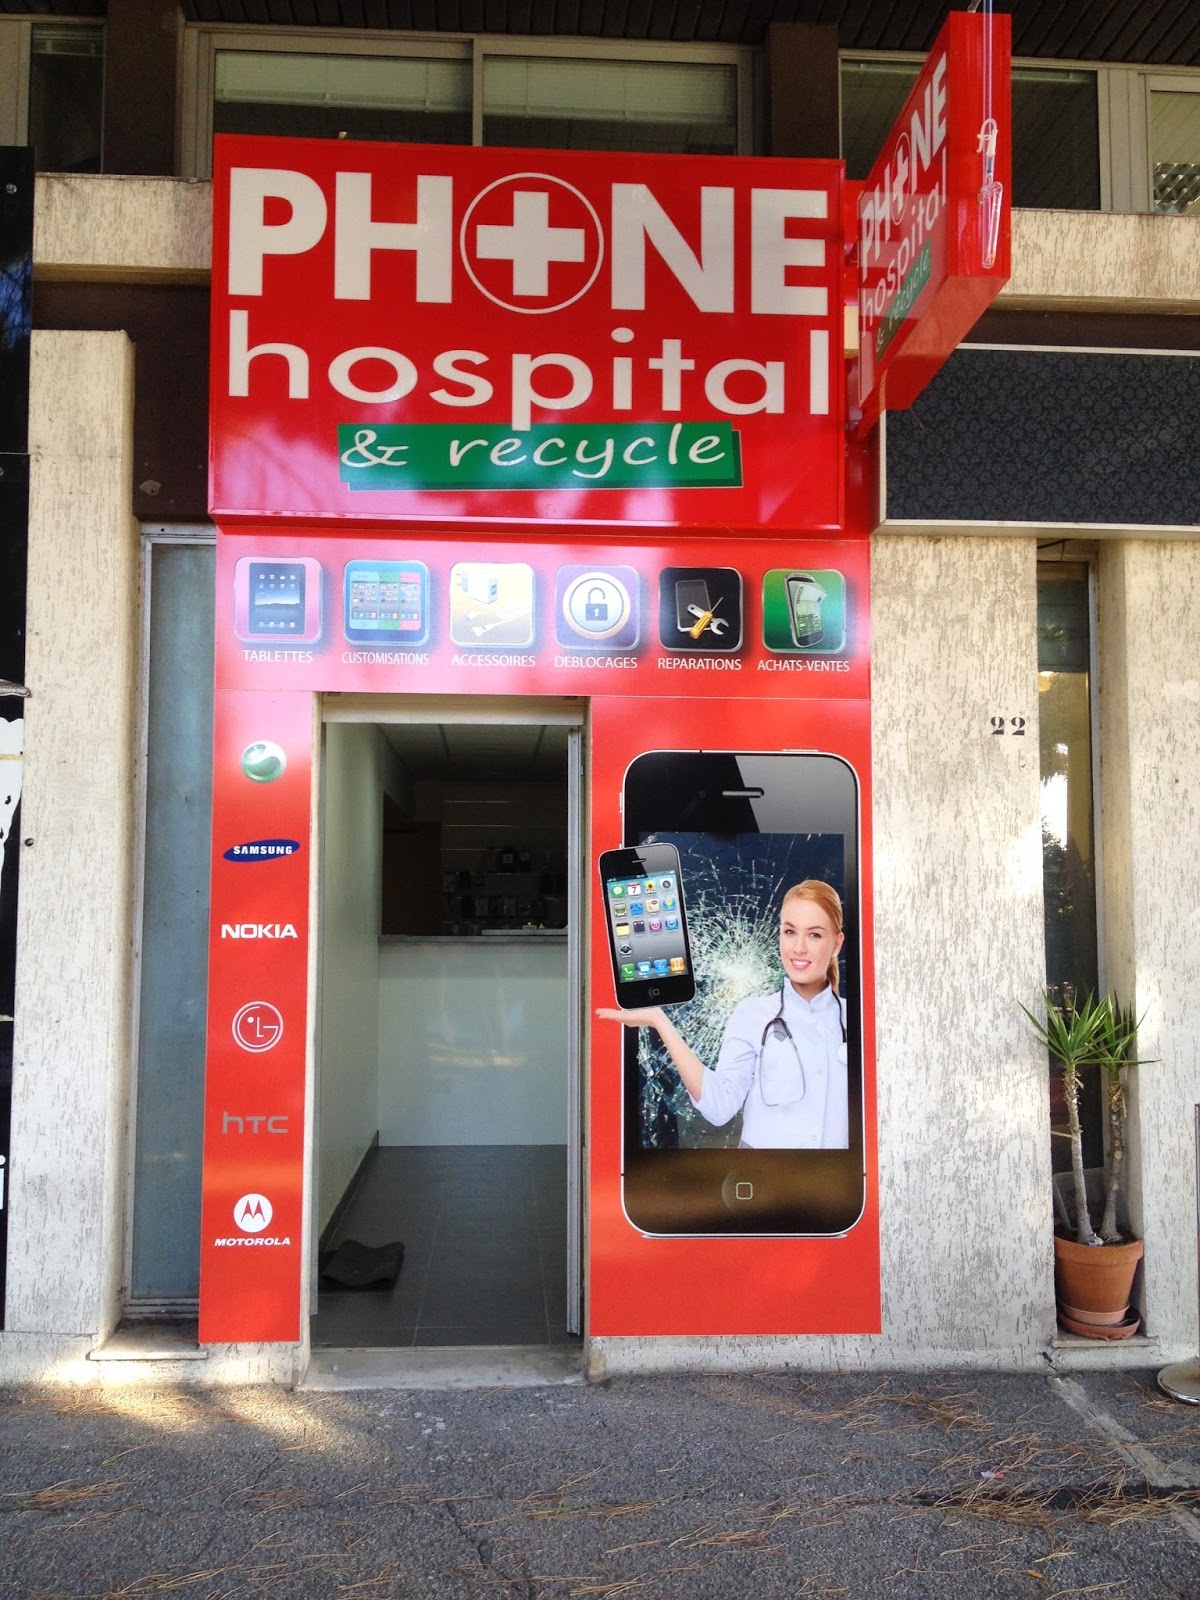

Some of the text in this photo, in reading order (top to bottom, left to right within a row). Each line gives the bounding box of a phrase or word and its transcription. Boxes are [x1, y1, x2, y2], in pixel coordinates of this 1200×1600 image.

[862, 147, 947, 338] hospital
[889, 247, 930, 331] recycle
[228, 309, 830, 431] hospital
[341, 422, 726, 479] & recycle
[242, 649, 314, 664] TABLETTES
[341, 651, 430, 666] CUSTOMISATIONS
[451, 654, 536, 668] ACCESSOIRES
[554, 656, 638, 670] DEBLOCAGES
[657, 657, 742, 671] REPARATIONS
[757, 659, 850, 673] ACHATS-VENTES
[990, 716, 1026, 736] 22
[233, 845, 293, 855] SAMSUNG
[221, 923, 298, 939] NOKIA
[234, 1003, 282, 1050] LG
[214, 1237, 291, 1247] MOTOROLA
